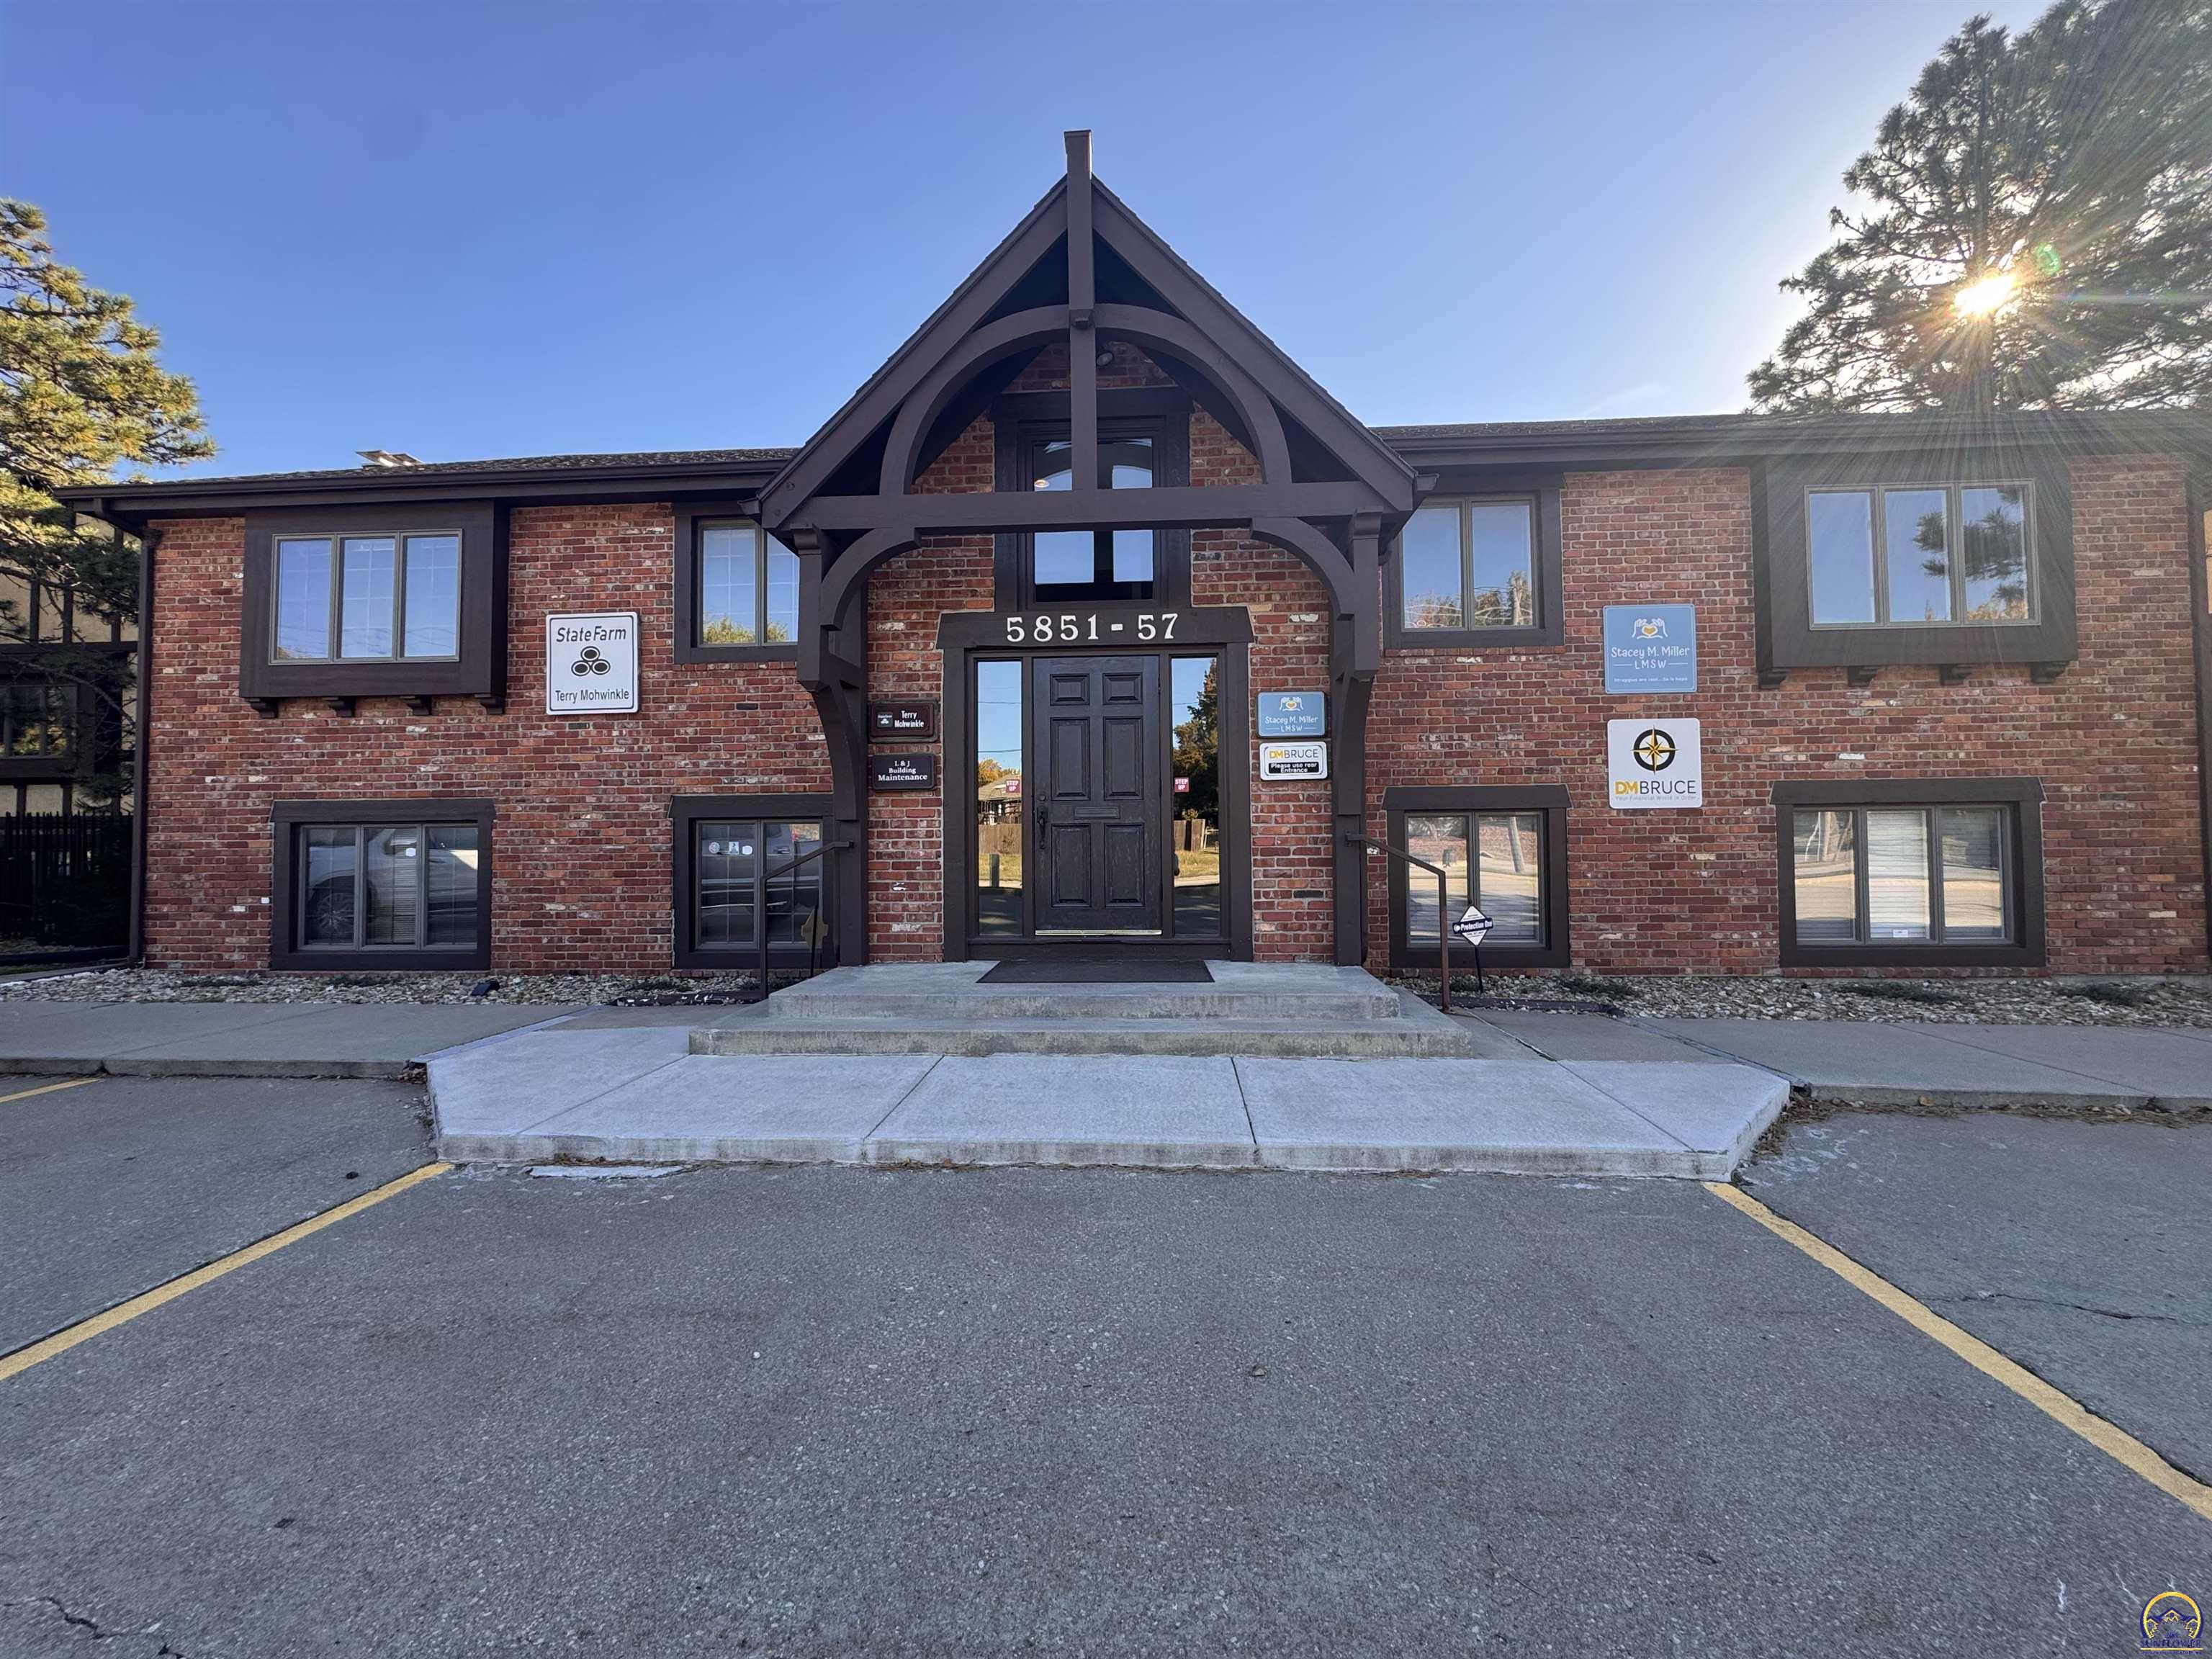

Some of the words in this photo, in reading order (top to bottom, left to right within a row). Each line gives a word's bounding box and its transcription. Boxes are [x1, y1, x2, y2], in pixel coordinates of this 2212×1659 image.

[1611, 647, 1645, 659] Stacey
[1647, 647, 1659, 657] M.
[1661, 646, 1690, 657] Miller
[1635, 660, 1666, 670] LMSW
[555, 690, 577, 703] Terry
[580, 688, 629, 701] Mohwinkle
[901, 710, 917, 719] Terry
[1264, 716, 1288, 725] Stacey
